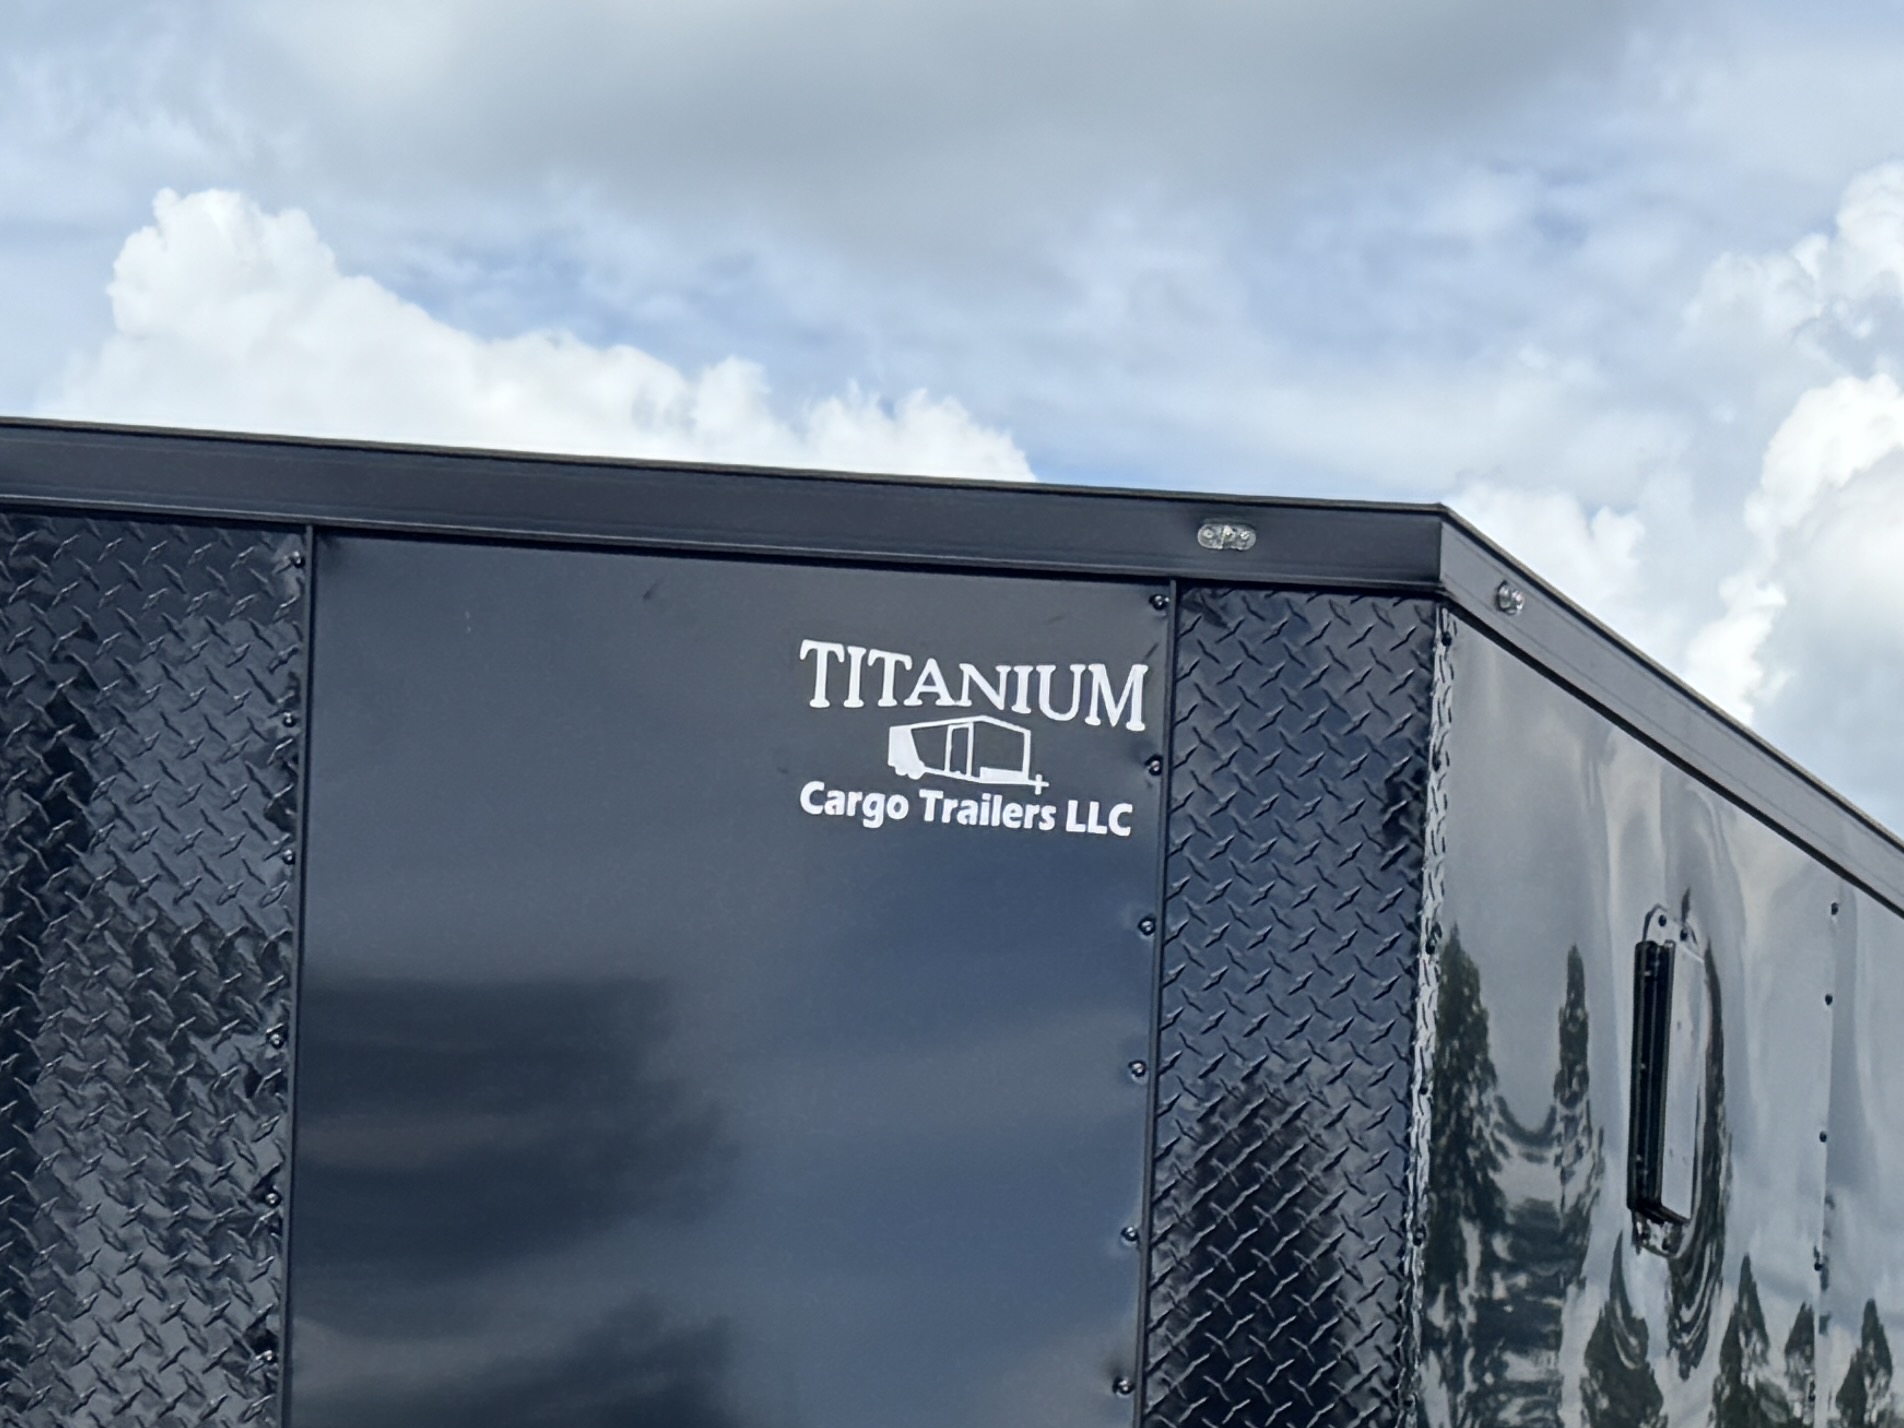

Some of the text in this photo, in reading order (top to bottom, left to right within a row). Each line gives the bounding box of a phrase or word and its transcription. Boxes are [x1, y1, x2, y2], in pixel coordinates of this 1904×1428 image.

[799, 639, 1149, 731] TITANIUM
[799, 781, 1134, 836] Cargo Trailers LLC
